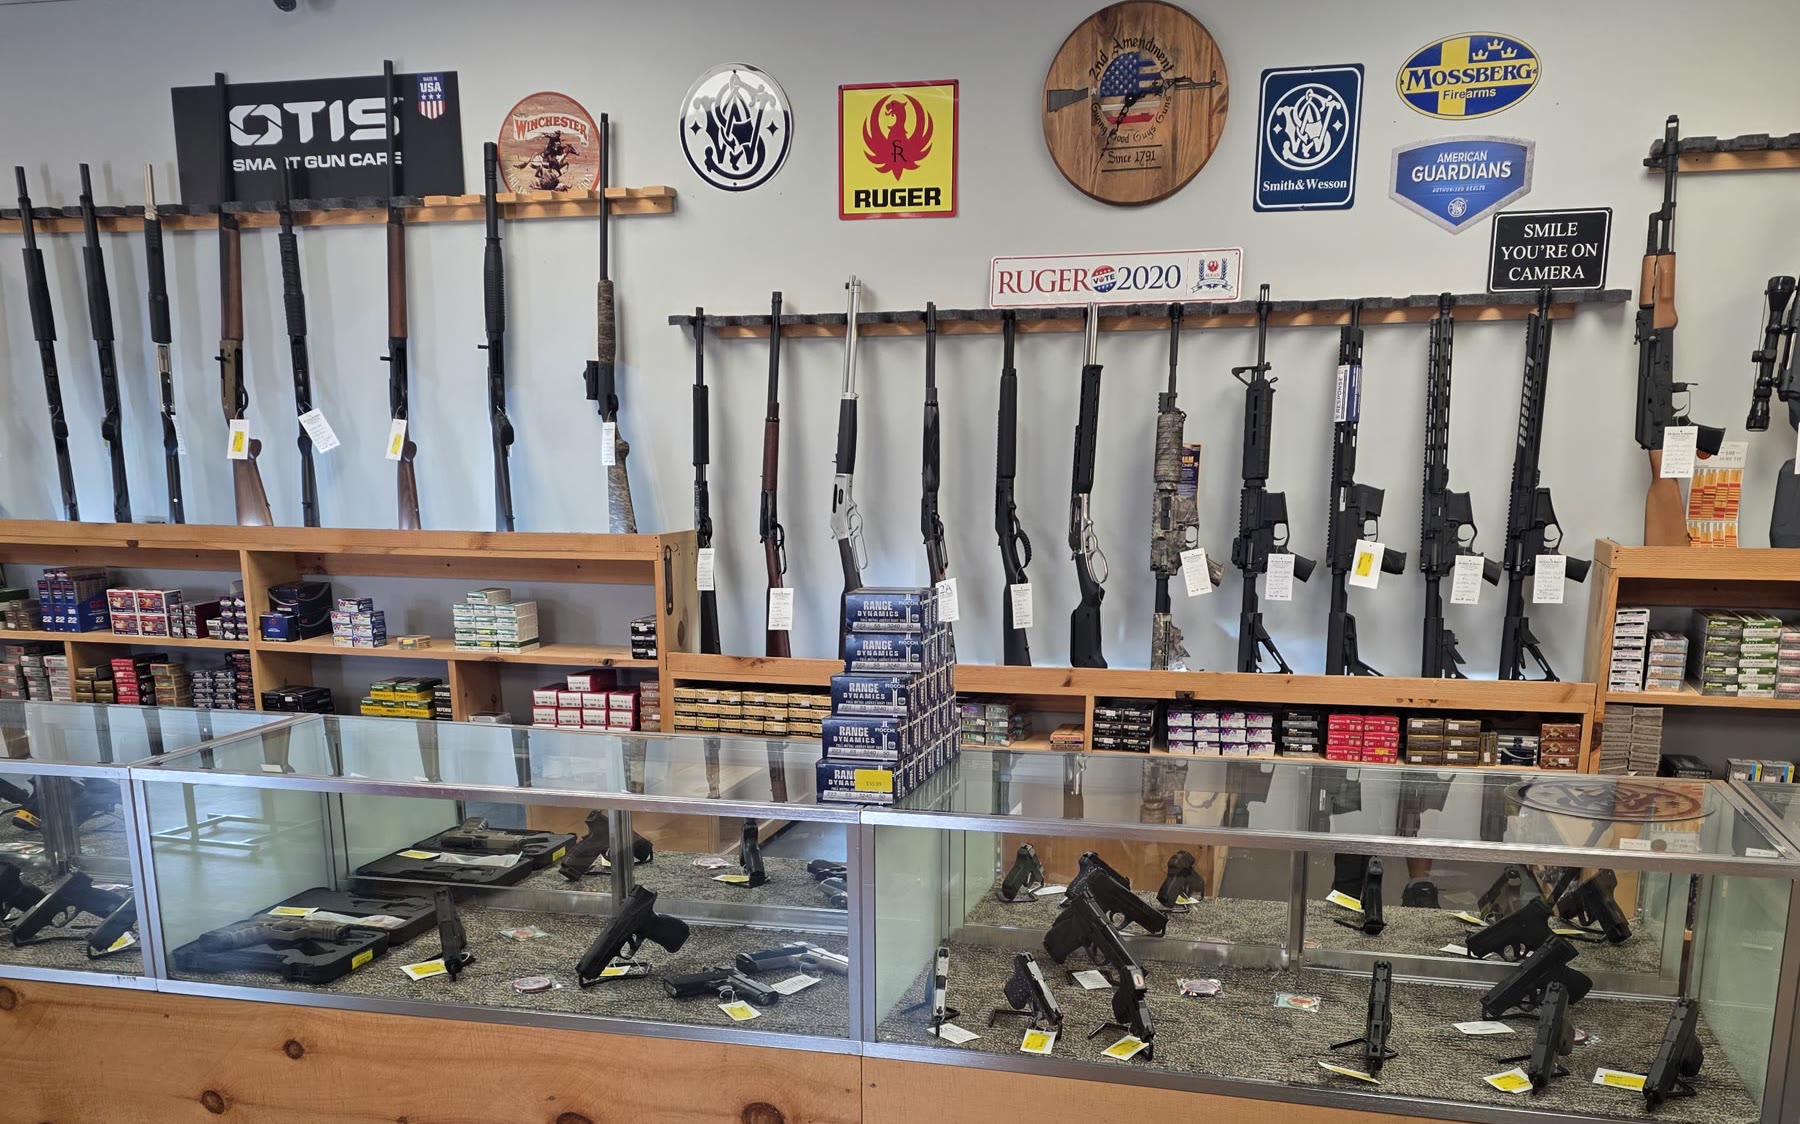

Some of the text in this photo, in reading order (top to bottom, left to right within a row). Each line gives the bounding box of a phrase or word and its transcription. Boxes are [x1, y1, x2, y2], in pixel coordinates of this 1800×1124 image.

[1089, 37, 1174, 81] 2nd Amendment
[1406, 63, 1532, 91] MOSSBERG
[420, 82, 442, 93] USA
[1443, 88, 1496, 100] Firearms
[1155, 96, 1172, 124] Guns
[229, 97, 400, 146] OTIS
[513, 116, 588, 140] WINCHESTER
[304, 154, 346, 169] GUN
[1107, 150, 1156, 166] Since 1791
[1437, 150, 1488, 163] AMERICAN
[1411, 160, 1512, 183] GUARDIANS
[854, 187, 941, 208] RUGER
[1524, 222, 1578, 238] SMILE
[1501, 242, 1598, 260] YOU'RE ON
[998, 267, 1093, 294] RUGER
[1116, 265, 1181, 290] 2020
[1509, 265, 1585, 281] CAMERA
[864, 601, 893, 610] RANGE
[863, 641, 892, 649] RANGE
[849, 683, 879, 693] RANGE
[839, 726, 868, 736] RANGE
[834, 770, 854, 779] RAN
